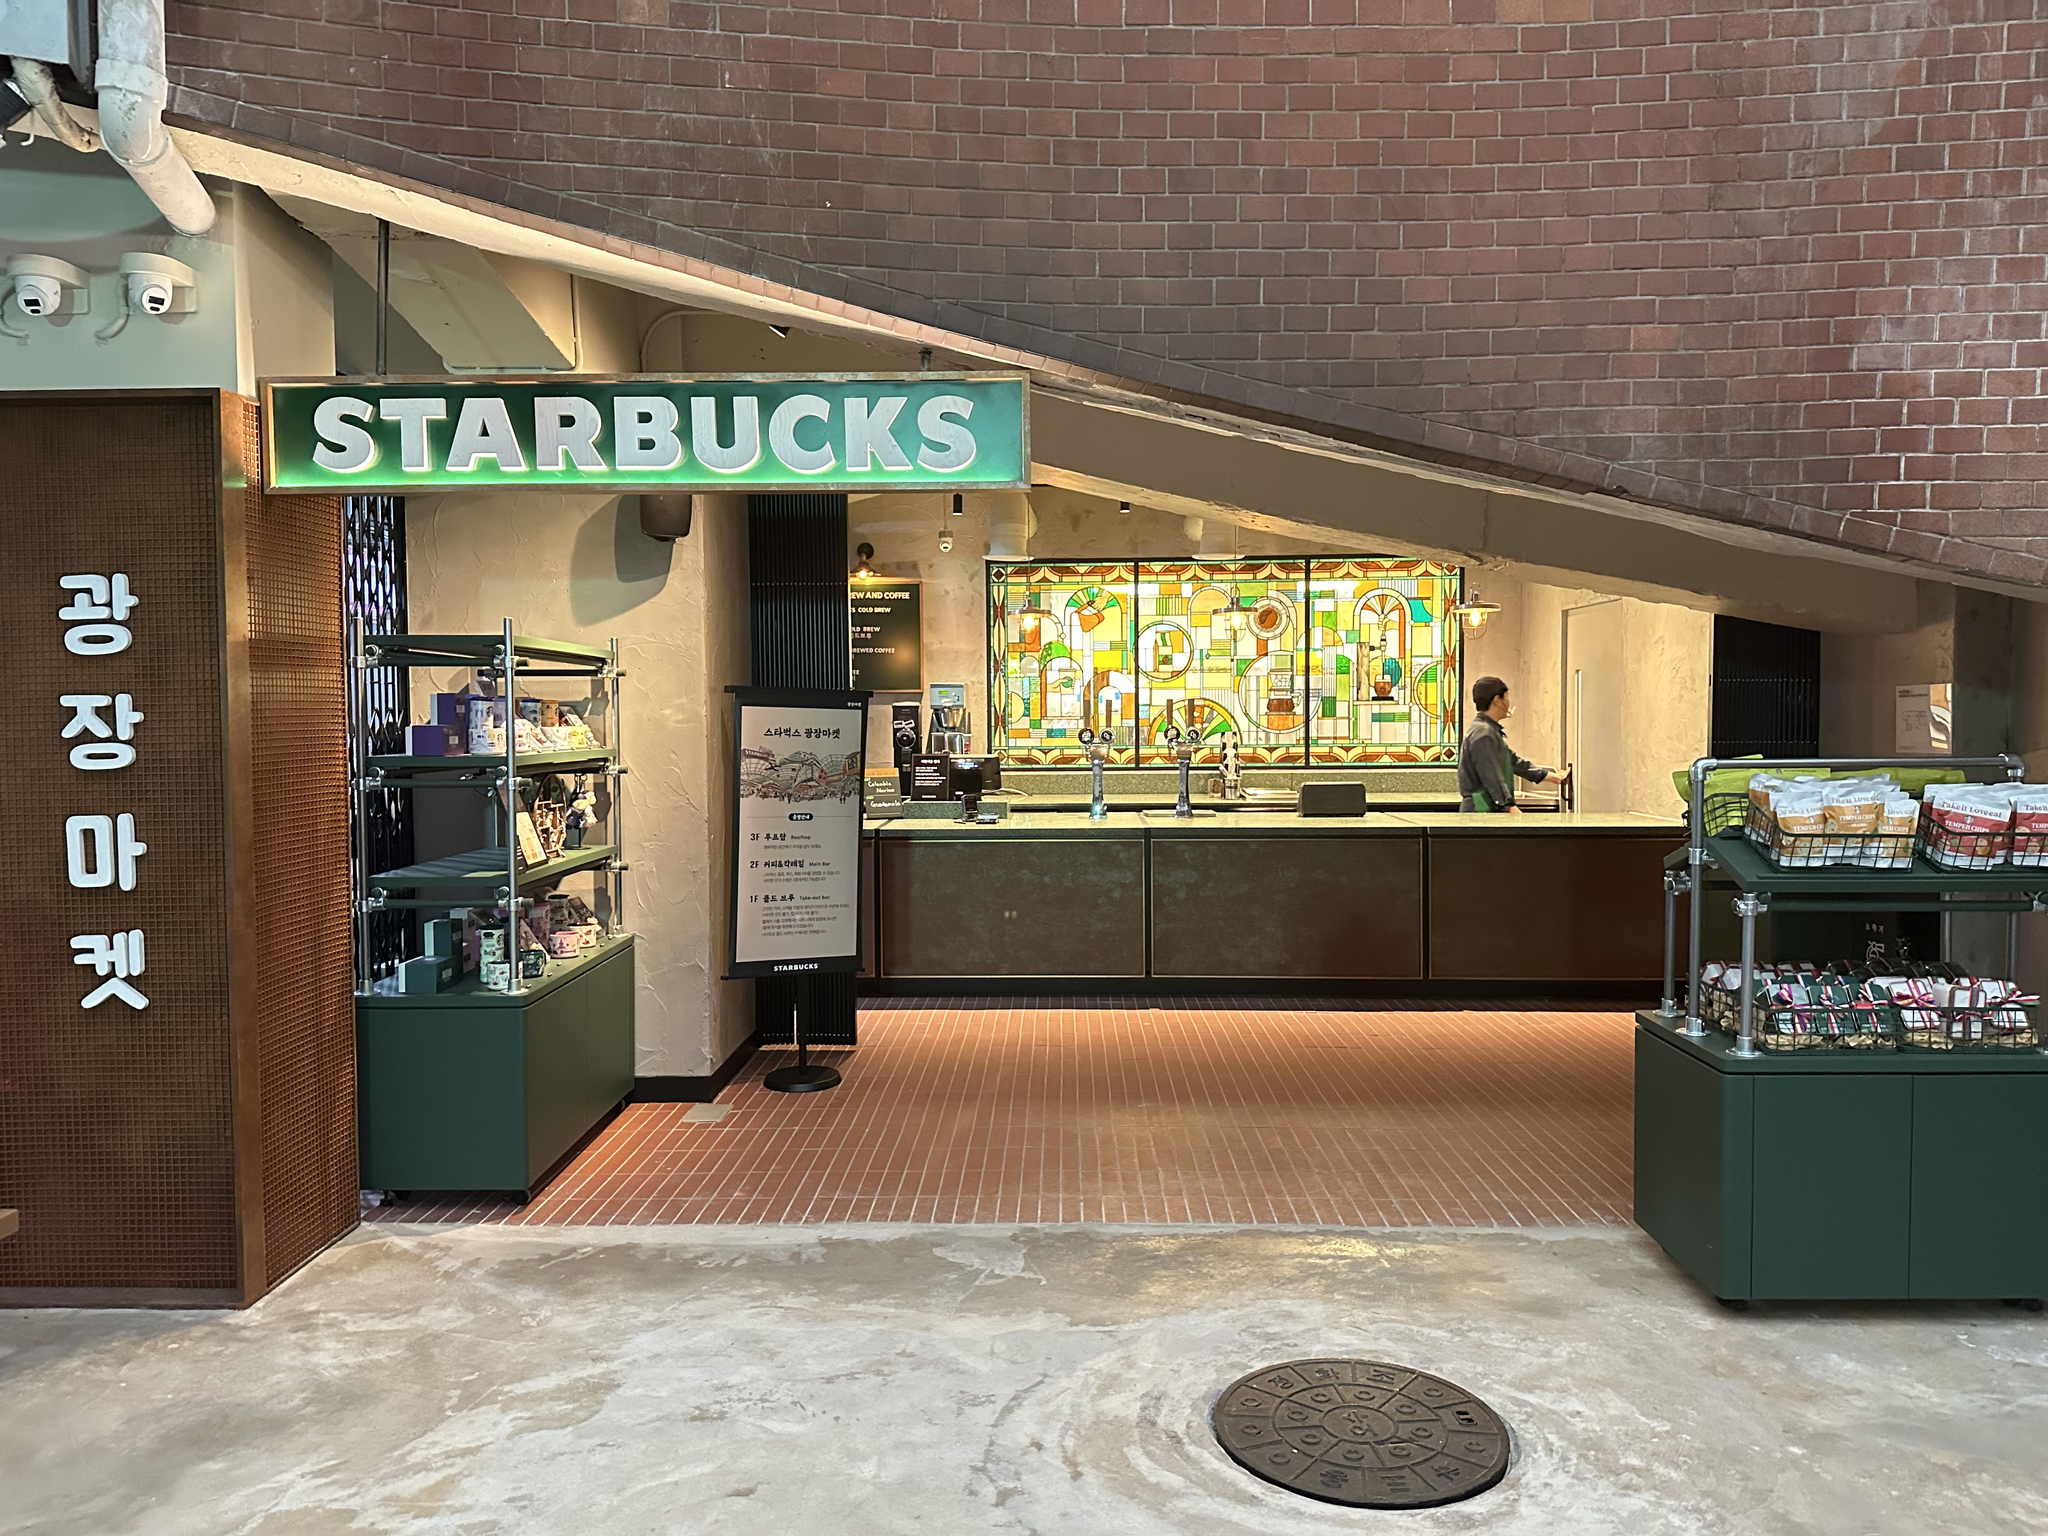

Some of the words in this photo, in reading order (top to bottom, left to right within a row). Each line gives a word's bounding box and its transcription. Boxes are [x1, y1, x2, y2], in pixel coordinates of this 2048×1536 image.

[312, 395, 978, 475] STARBUCKS
[865, 591, 883, 599] AND
[884, 591, 910, 599] COFFEE
[763, 727, 802, 738] 스타벅스
[804, 728, 841, 739] 광장마켓
[58, 572, 150, 1010] 광장마켓
[1945, 820, 1971, 831] TEMPEH
[750, 832, 760, 841] 3F
[764, 832, 787, 841] 루프탑
[750, 860, 760, 868] 2F
[763, 859, 805, 868] 커피&칵테일
[749, 894, 759, 903] 1F
[762, 894, 778, 903] 콜드
[779, 893, 796, 902] 브루
[773, 963, 819, 972] STARBUCKS
